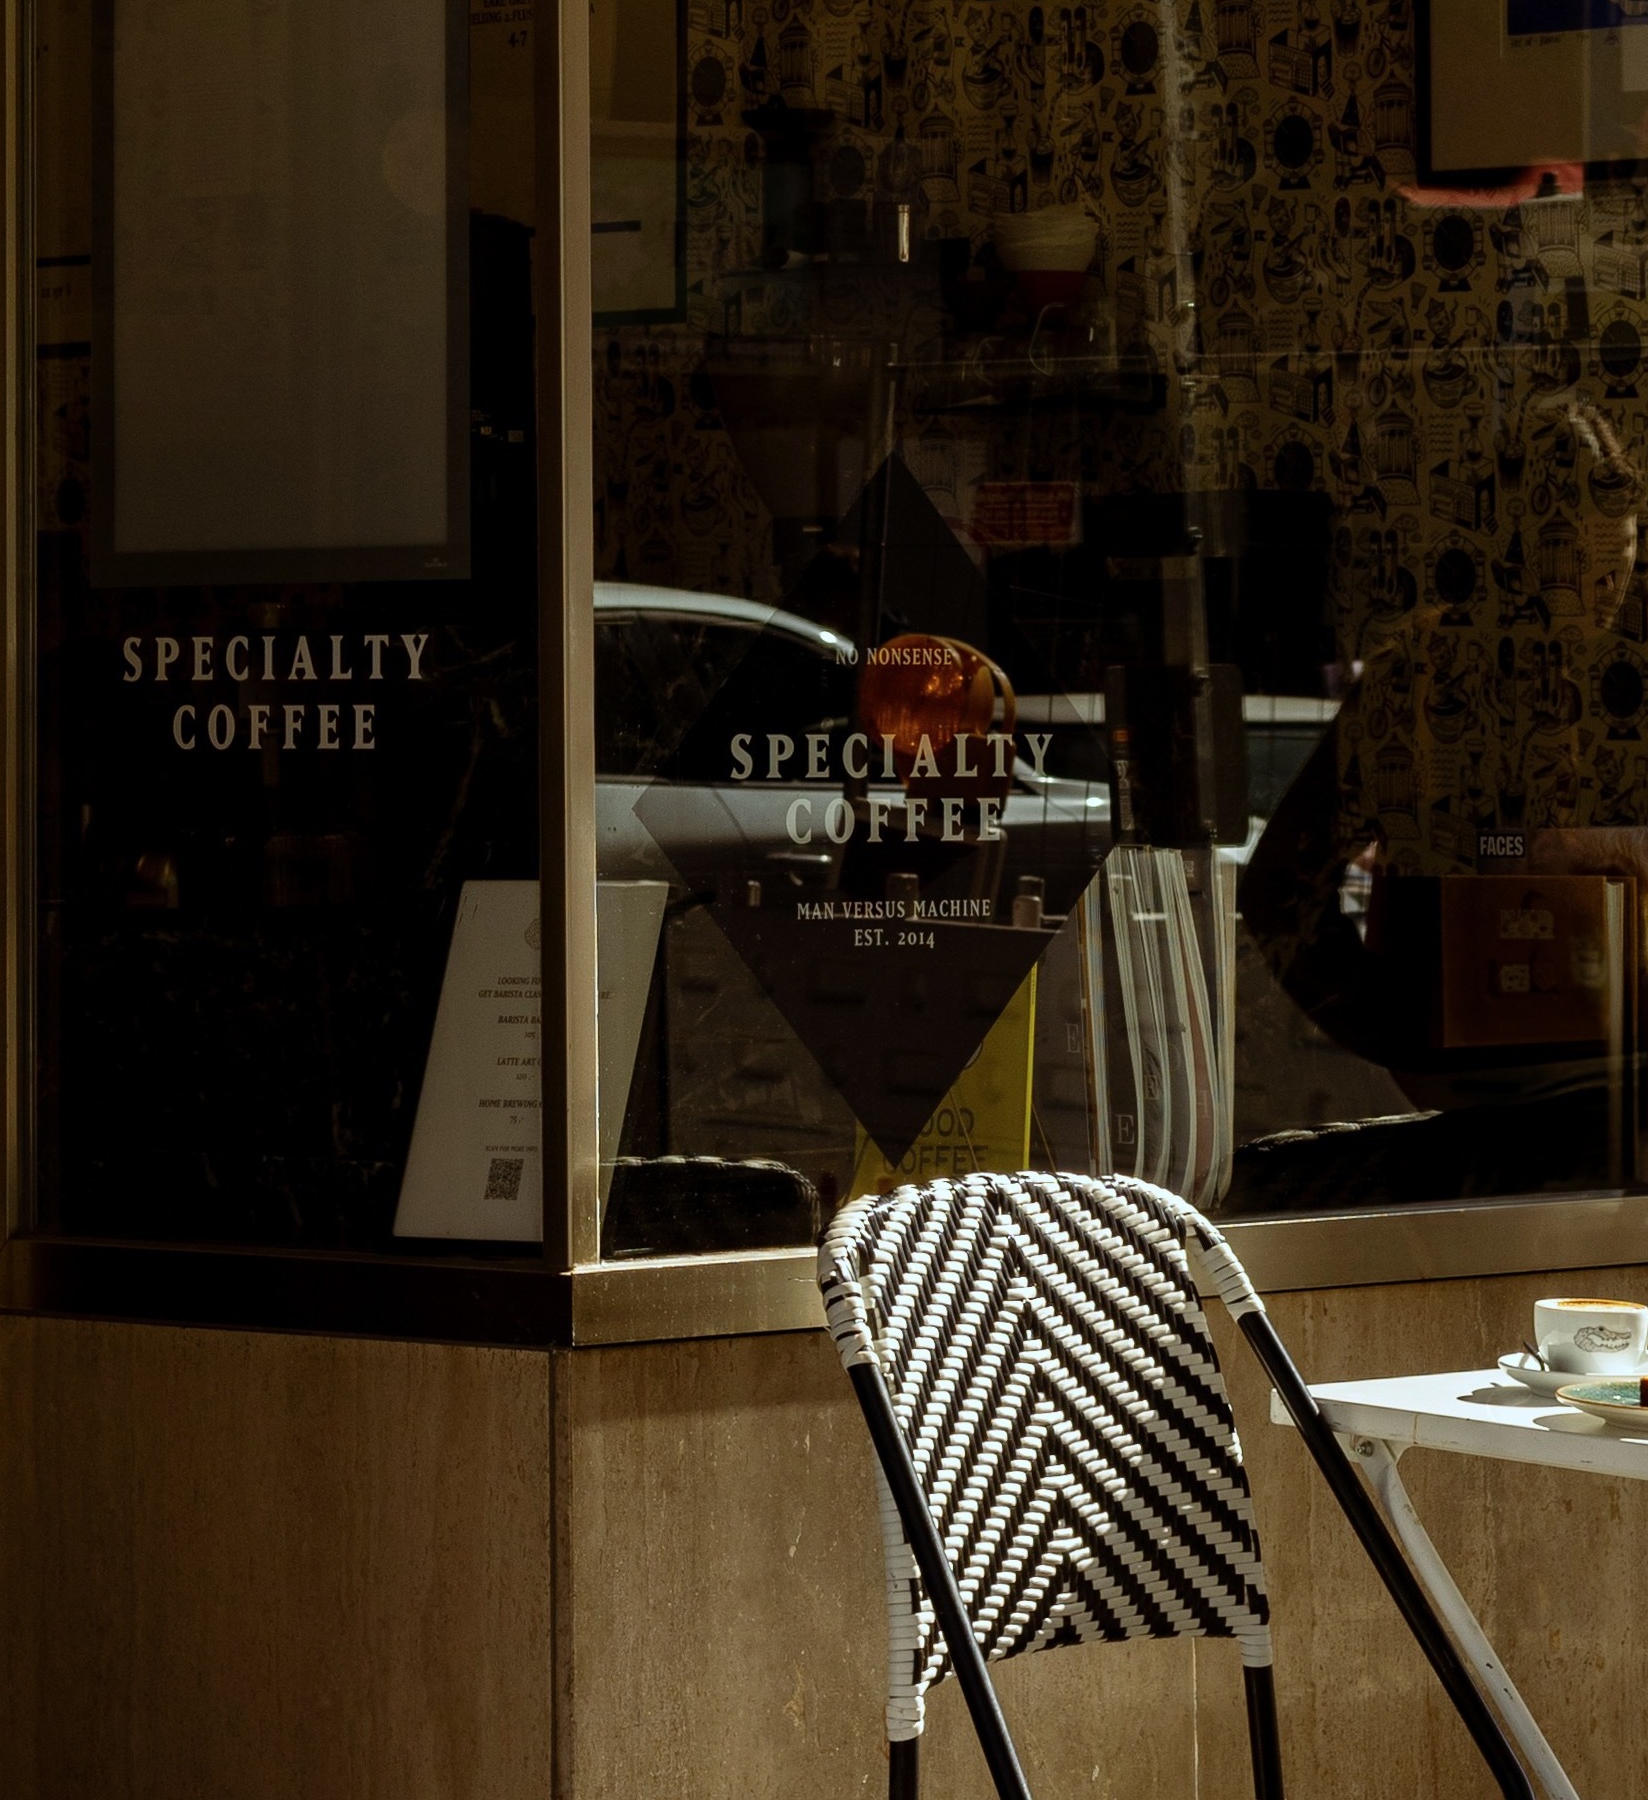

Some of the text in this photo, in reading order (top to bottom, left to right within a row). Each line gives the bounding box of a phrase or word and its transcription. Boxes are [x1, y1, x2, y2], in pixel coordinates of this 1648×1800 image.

[121, 633, 430, 682] SPECIALTY
[835, 646, 953, 666] NO NONSENSE
[172, 703, 378, 752] COFFEE
[729, 732, 1054, 782] SPECIALTY
[785, 797, 1002, 845] COFFEE
[1479, 835, 1525, 857] FACES
[797, 898, 991, 920] MAN VERSUS MACHINE
[854, 928, 936, 949] EST. 2014
[497, 976, 542, 985] LOOKING FO
[478, 990, 492, 999] GET
[493, 989, 523, 999] BARISTA
[498, 1015, 529, 1025] BARISTA
[497, 1057, 520, 1067] LATTE
[521, 1057, 537, 1066] ART
[478, 1099, 501, 1108] HOME
[502, 1099, 538, 1108] BREWING
